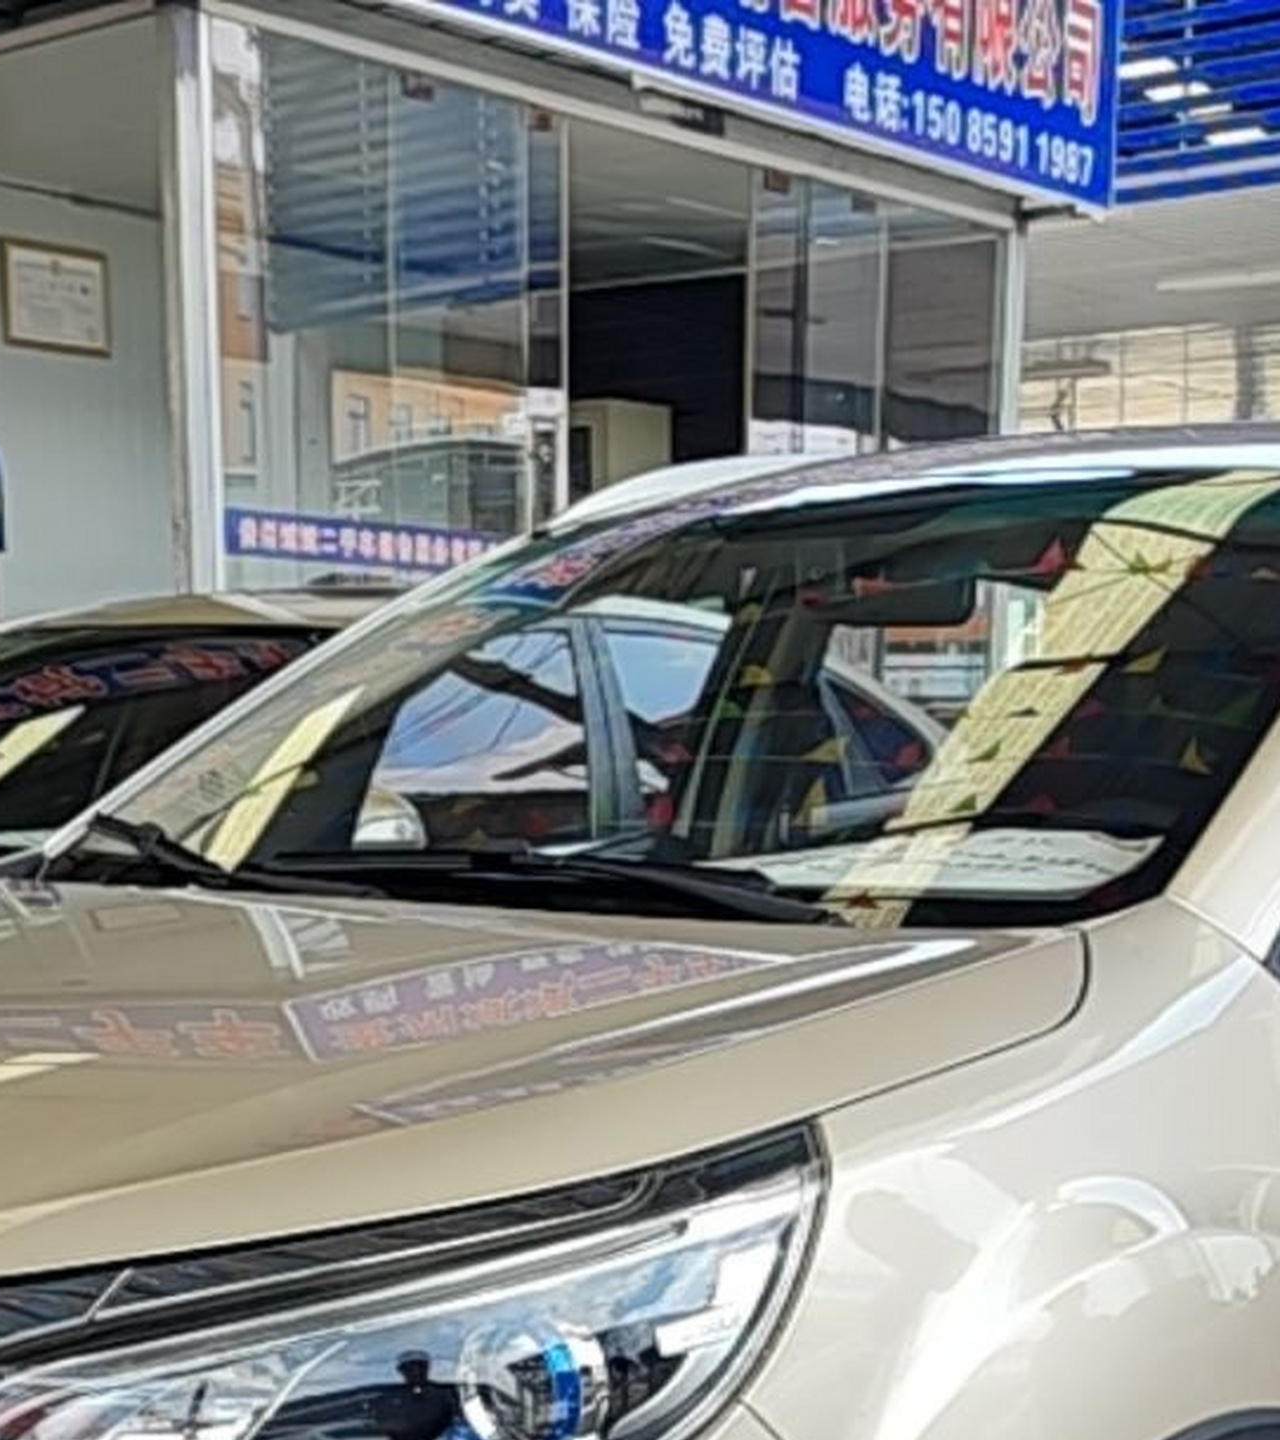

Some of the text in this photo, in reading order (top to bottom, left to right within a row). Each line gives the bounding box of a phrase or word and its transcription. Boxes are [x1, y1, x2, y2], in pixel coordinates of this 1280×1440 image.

[662, 9, 801, 100] 免费评估
[966, 107, 1029, 169] 8591
[1035, 131, 1095, 187] 1987
